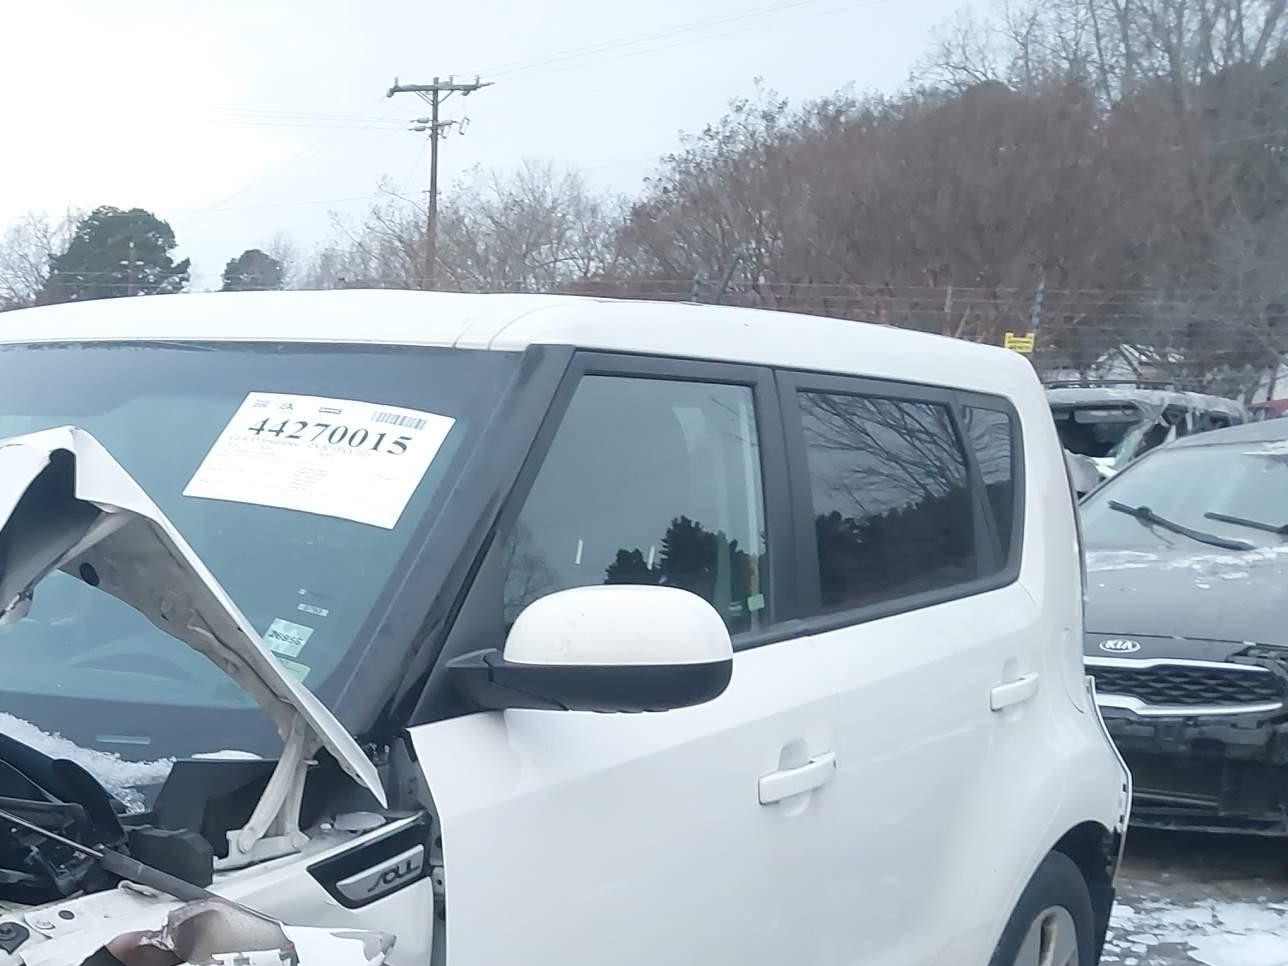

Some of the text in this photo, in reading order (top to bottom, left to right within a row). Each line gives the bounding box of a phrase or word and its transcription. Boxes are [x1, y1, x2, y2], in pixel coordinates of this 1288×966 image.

[248, 417, 413, 456] 44270015
[1104, 638, 1133, 650] KIA
[367, 859, 421, 893] SOUL
